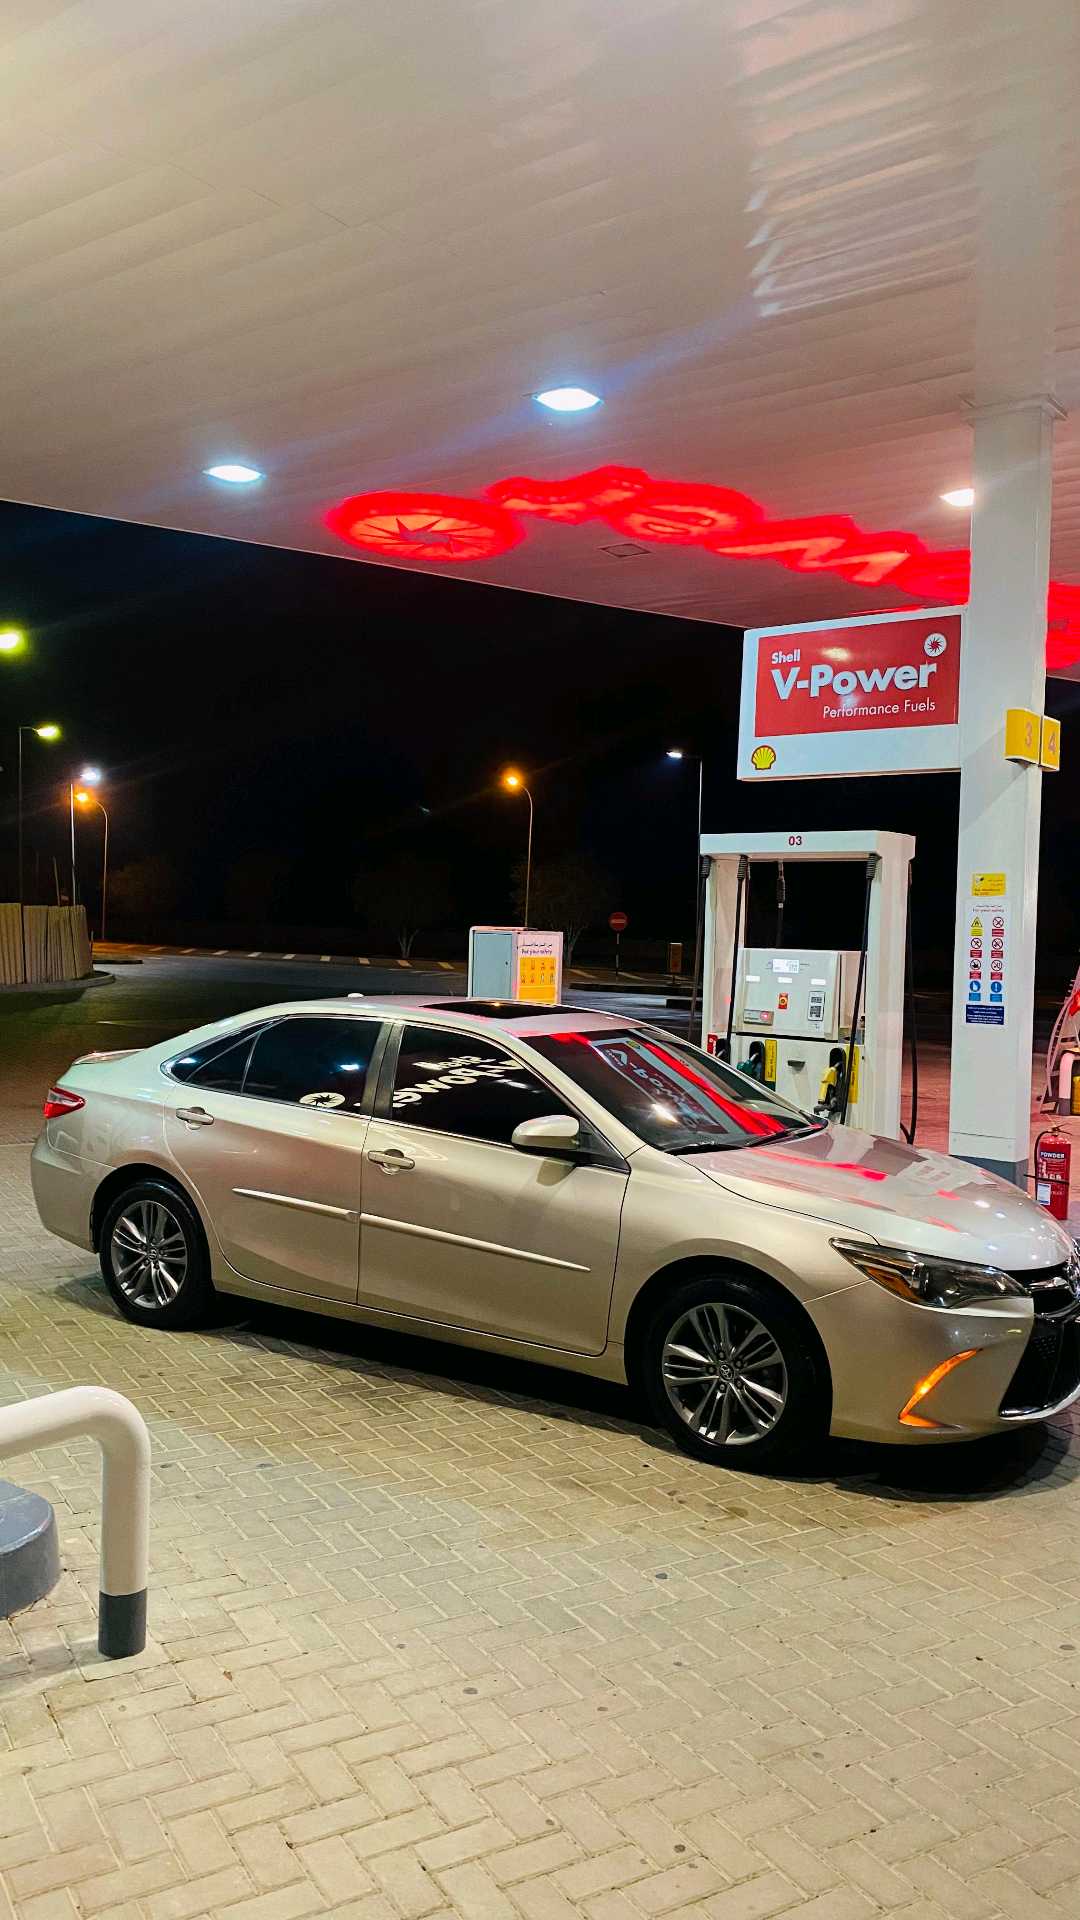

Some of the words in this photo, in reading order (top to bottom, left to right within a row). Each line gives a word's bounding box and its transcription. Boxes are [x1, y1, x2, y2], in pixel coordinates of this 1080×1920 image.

[771, 649, 800, 664] Shell
[771, 662, 937, 700] V-Power
[823, 703, 900, 719] Performance
[904, 697, 936, 713] Fuels
[1024, 720, 1033, 749] 3
[1048, 732, 1057, 755] 4
[788, 835, 802, 846] 03
[1040, 1151, 1065, 1159] POWDER
